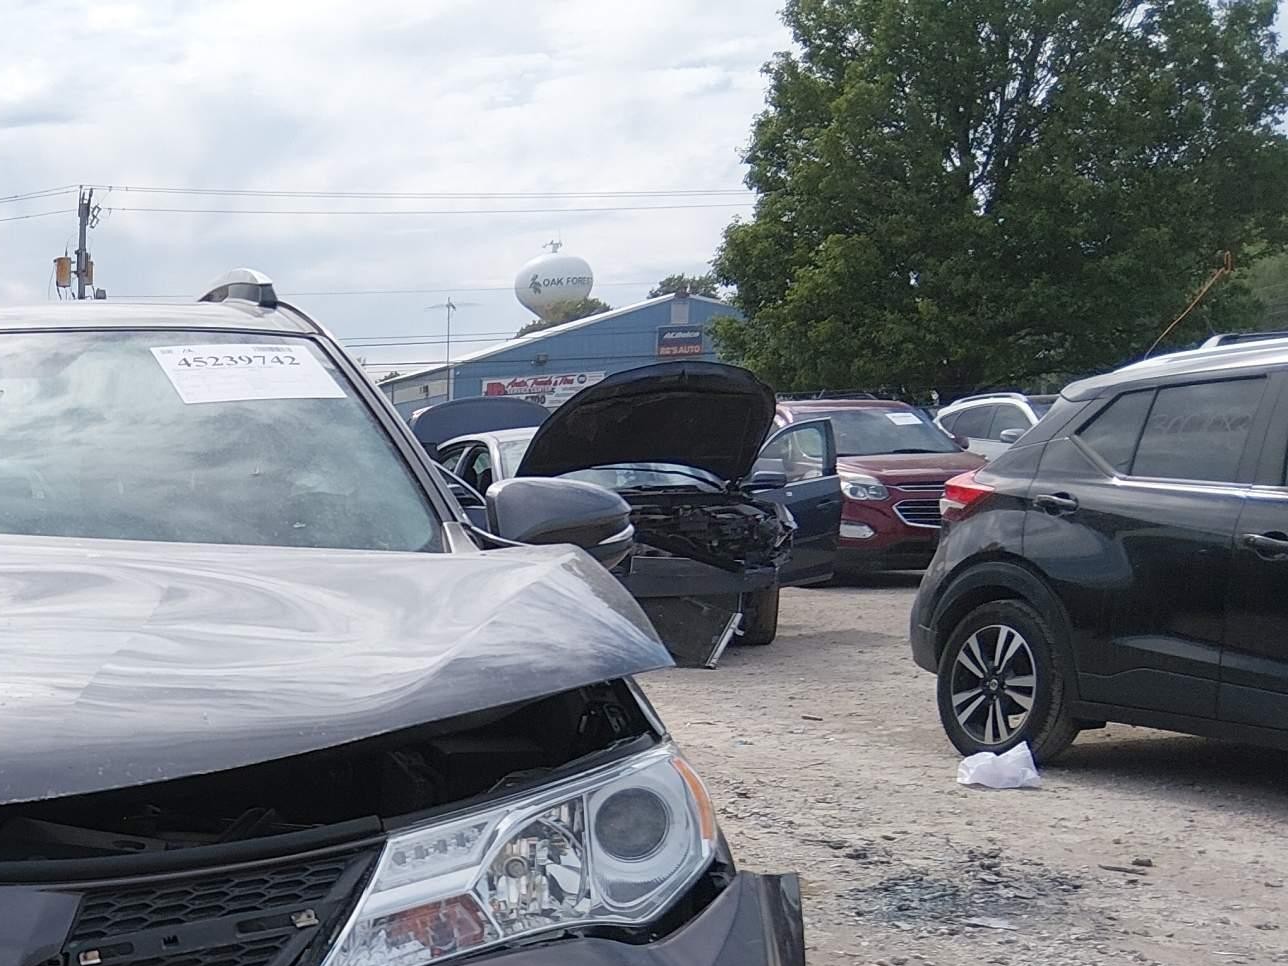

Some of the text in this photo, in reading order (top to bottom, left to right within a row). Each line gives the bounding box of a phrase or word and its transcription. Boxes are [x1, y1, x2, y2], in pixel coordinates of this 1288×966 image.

[543, 277, 564, 287] OAK
[679, 344, 701, 354] AUTO
[178, 355, 300, 367] 45239742
